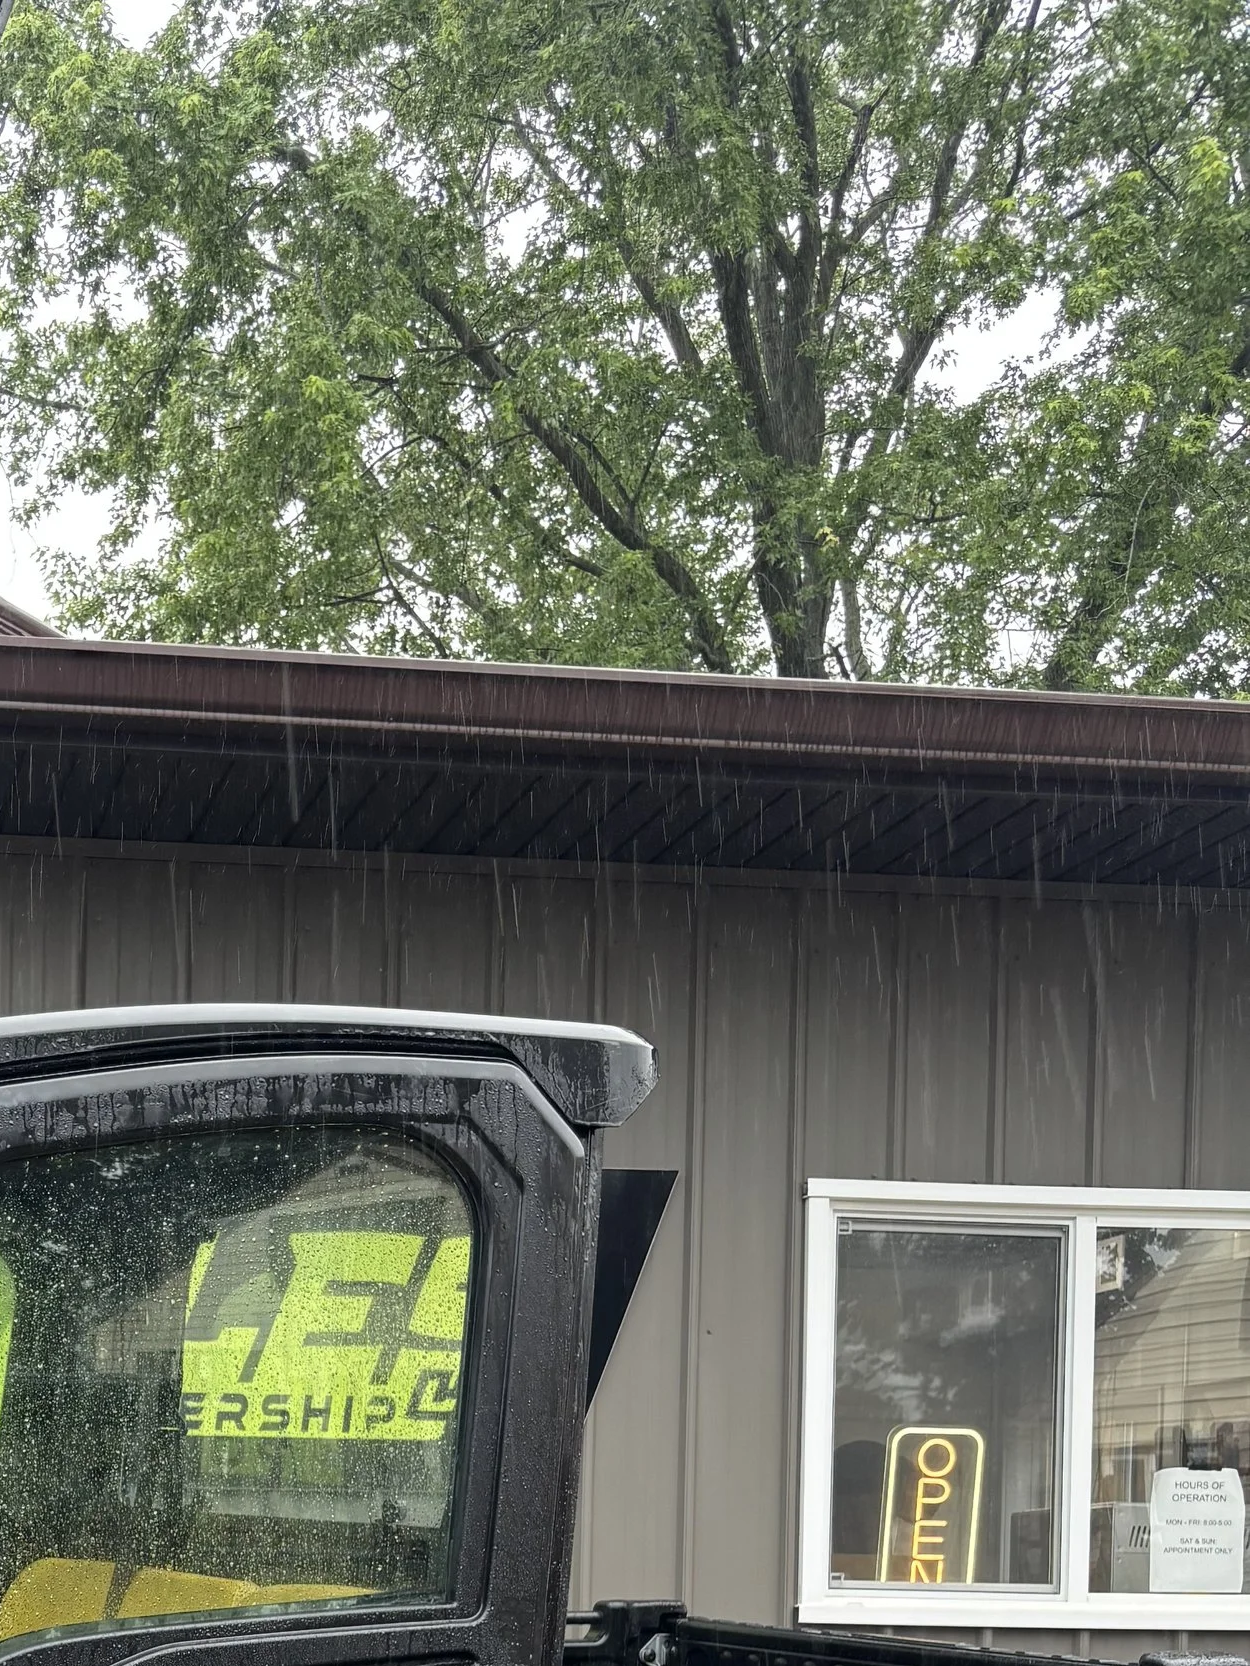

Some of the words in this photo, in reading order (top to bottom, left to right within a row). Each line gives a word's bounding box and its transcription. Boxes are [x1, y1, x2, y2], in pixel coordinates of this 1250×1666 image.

[179, 1391, 397, 1434] ERSHIP
[1174, 1480, 1209, 1490] HOURS
[1211, 1481, 1226, 1490] OF
[1171, 1493, 1227, 1503] OPERATION
[909, 1437, 957, 1584] OPEN
[1165, 1518, 1183, 1526] MON
[1179, 1537, 1193, 1545] SAT
[1163, 1546, 1212, 1554] APPOINTMENT
[1214, 1547, 1233, 1555] ONLY
